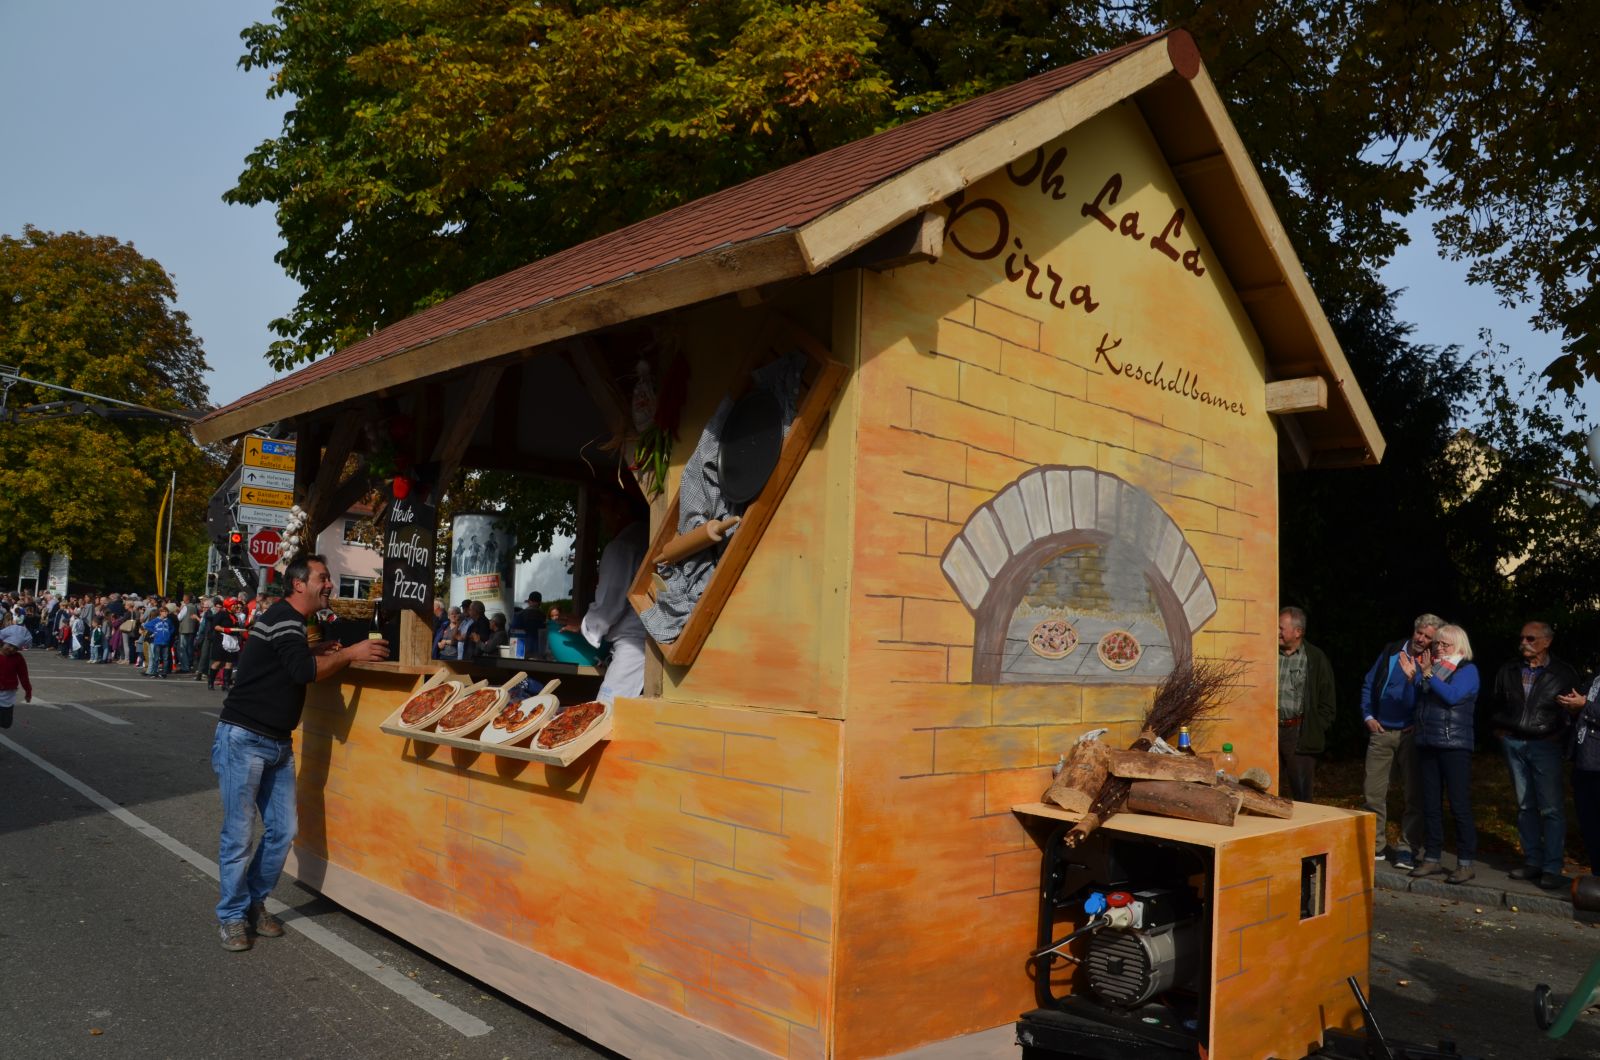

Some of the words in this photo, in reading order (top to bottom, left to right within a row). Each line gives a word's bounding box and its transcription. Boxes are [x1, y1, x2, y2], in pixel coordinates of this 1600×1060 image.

[941, 190, 1100, 314] Pizza
[1080, 173, 1145, 241] La
[1149, 207, 1206, 278] La
[1094, 332, 1248, 418] Keschdlbamer
[391, 499, 415, 523] Heute
[387, 534, 429, 566] Horaffen
[393, 568, 428, 604] Pizza
